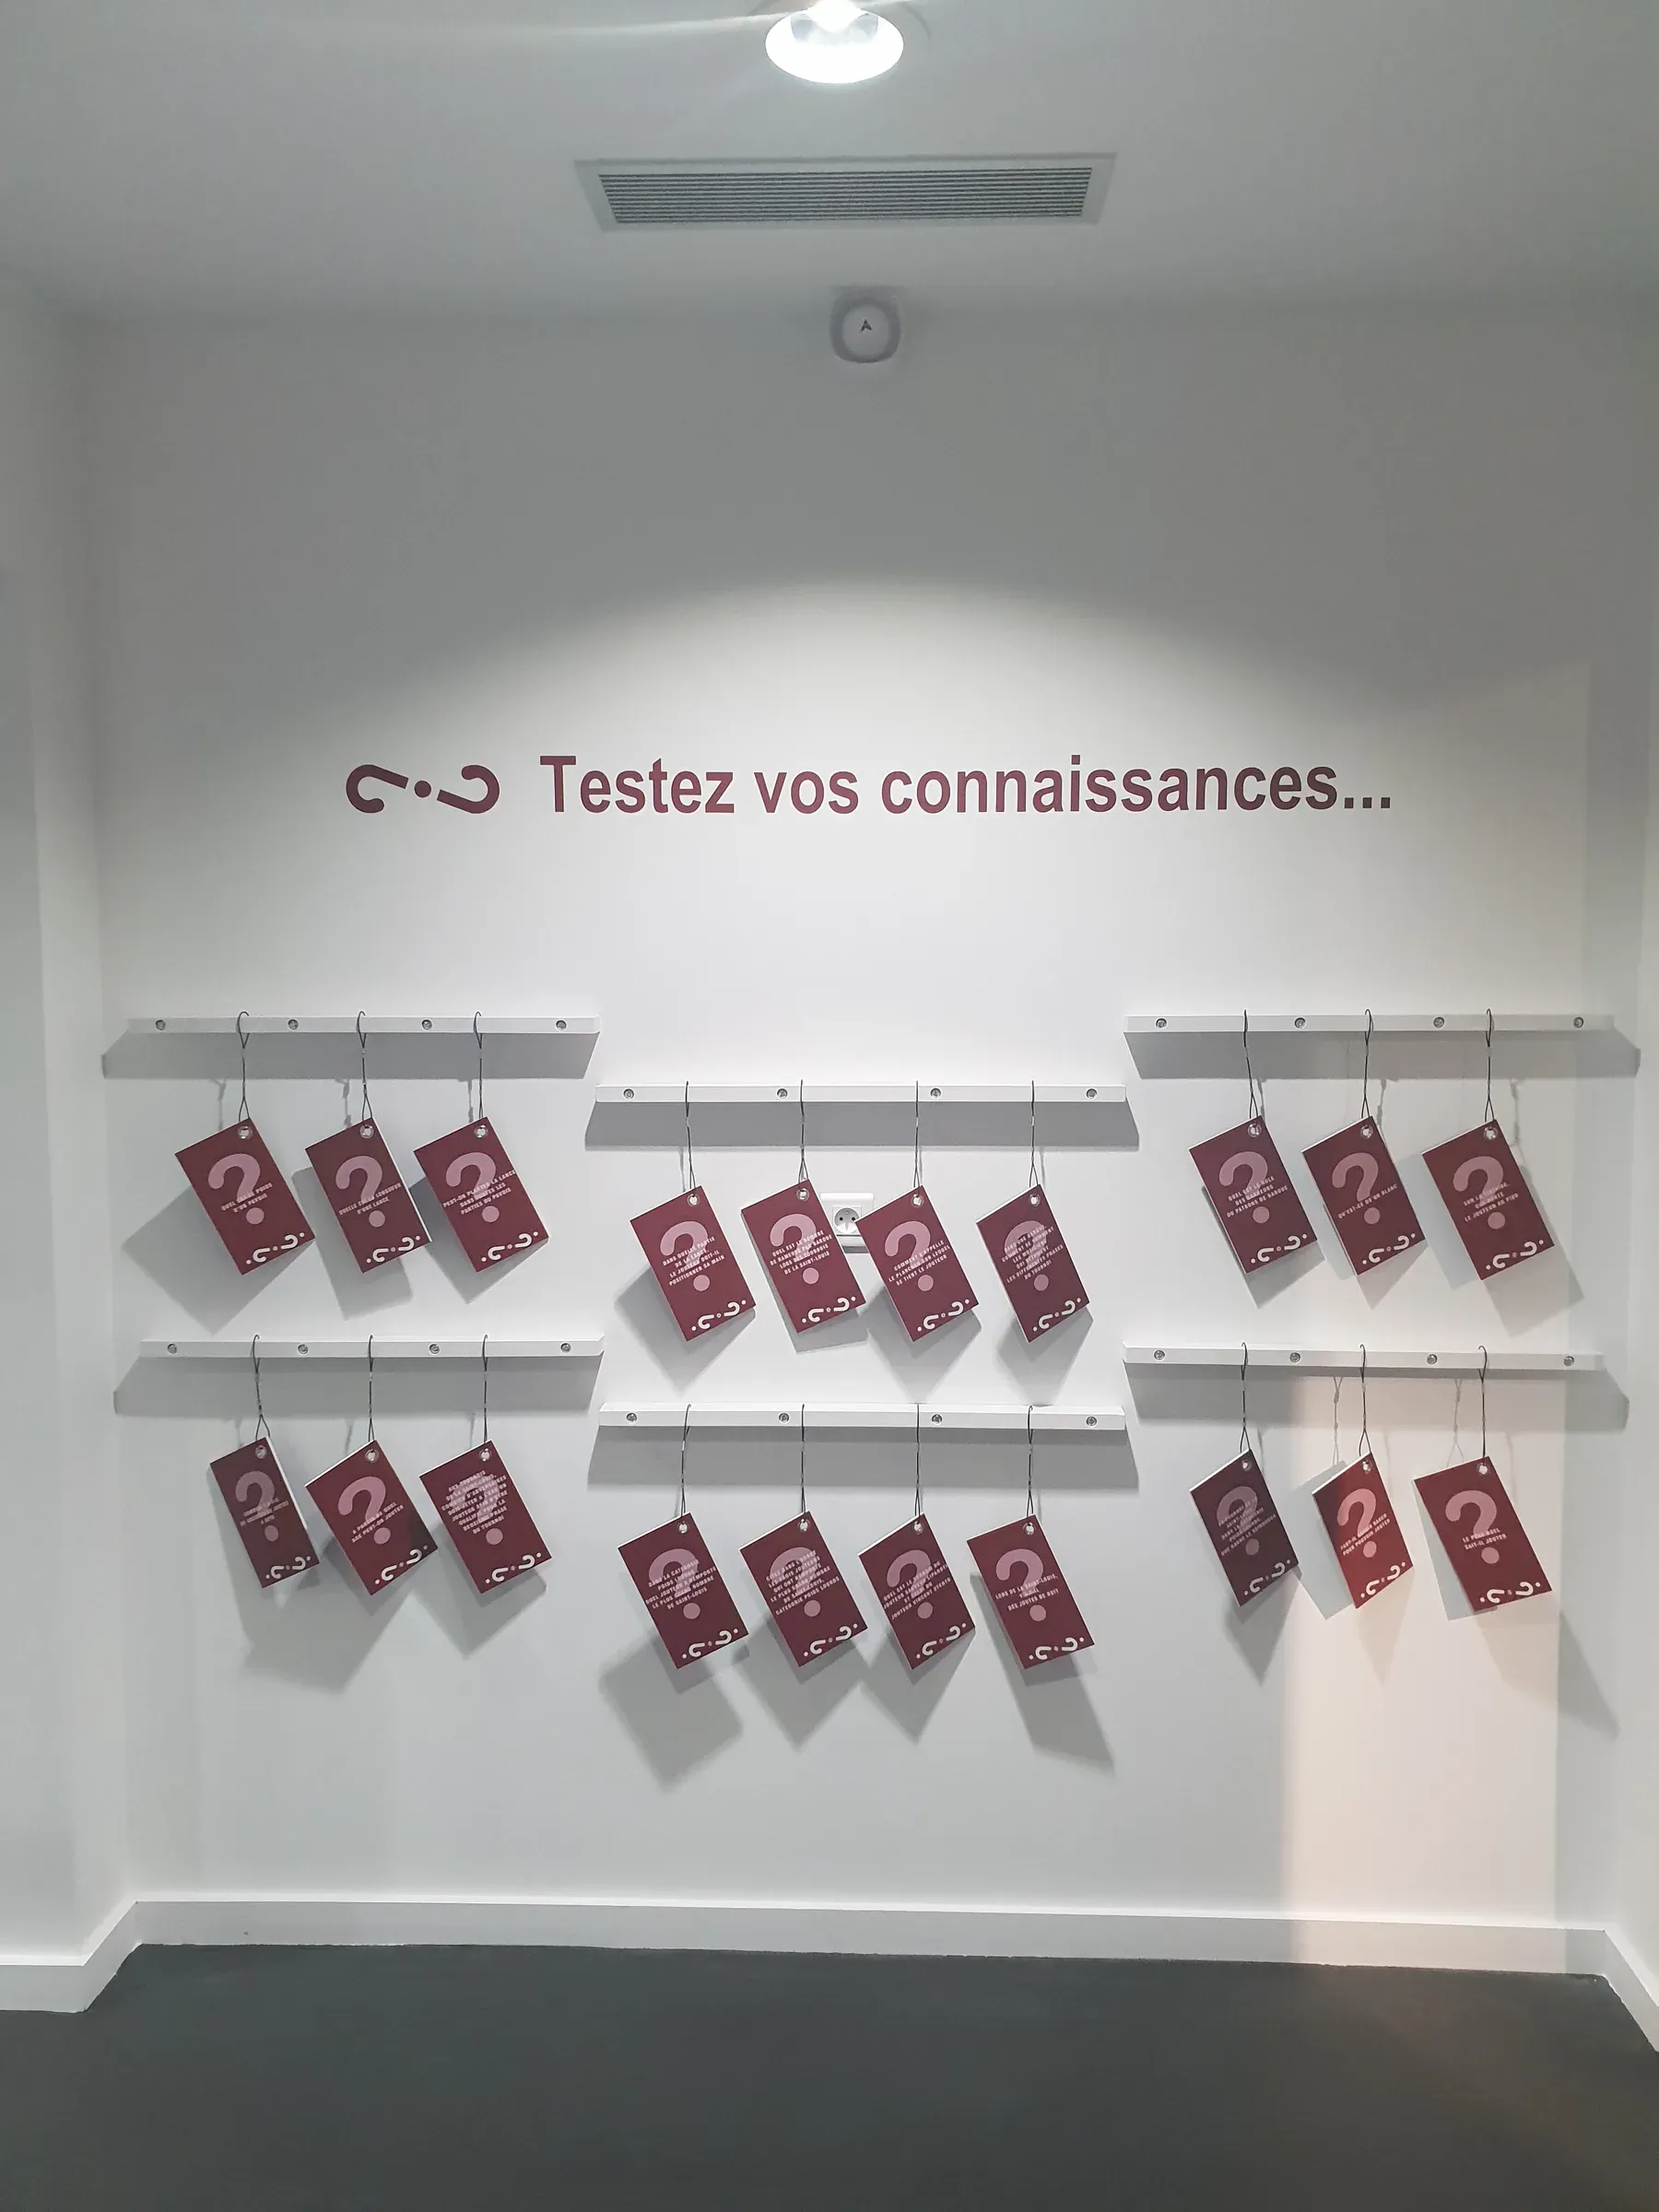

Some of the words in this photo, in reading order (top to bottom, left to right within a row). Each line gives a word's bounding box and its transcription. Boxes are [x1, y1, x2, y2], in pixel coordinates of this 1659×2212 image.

[540, 756, 734, 813] Testez
[754, 771, 858, 814] vos
[882, 755, 1390, 813] connaissances...
